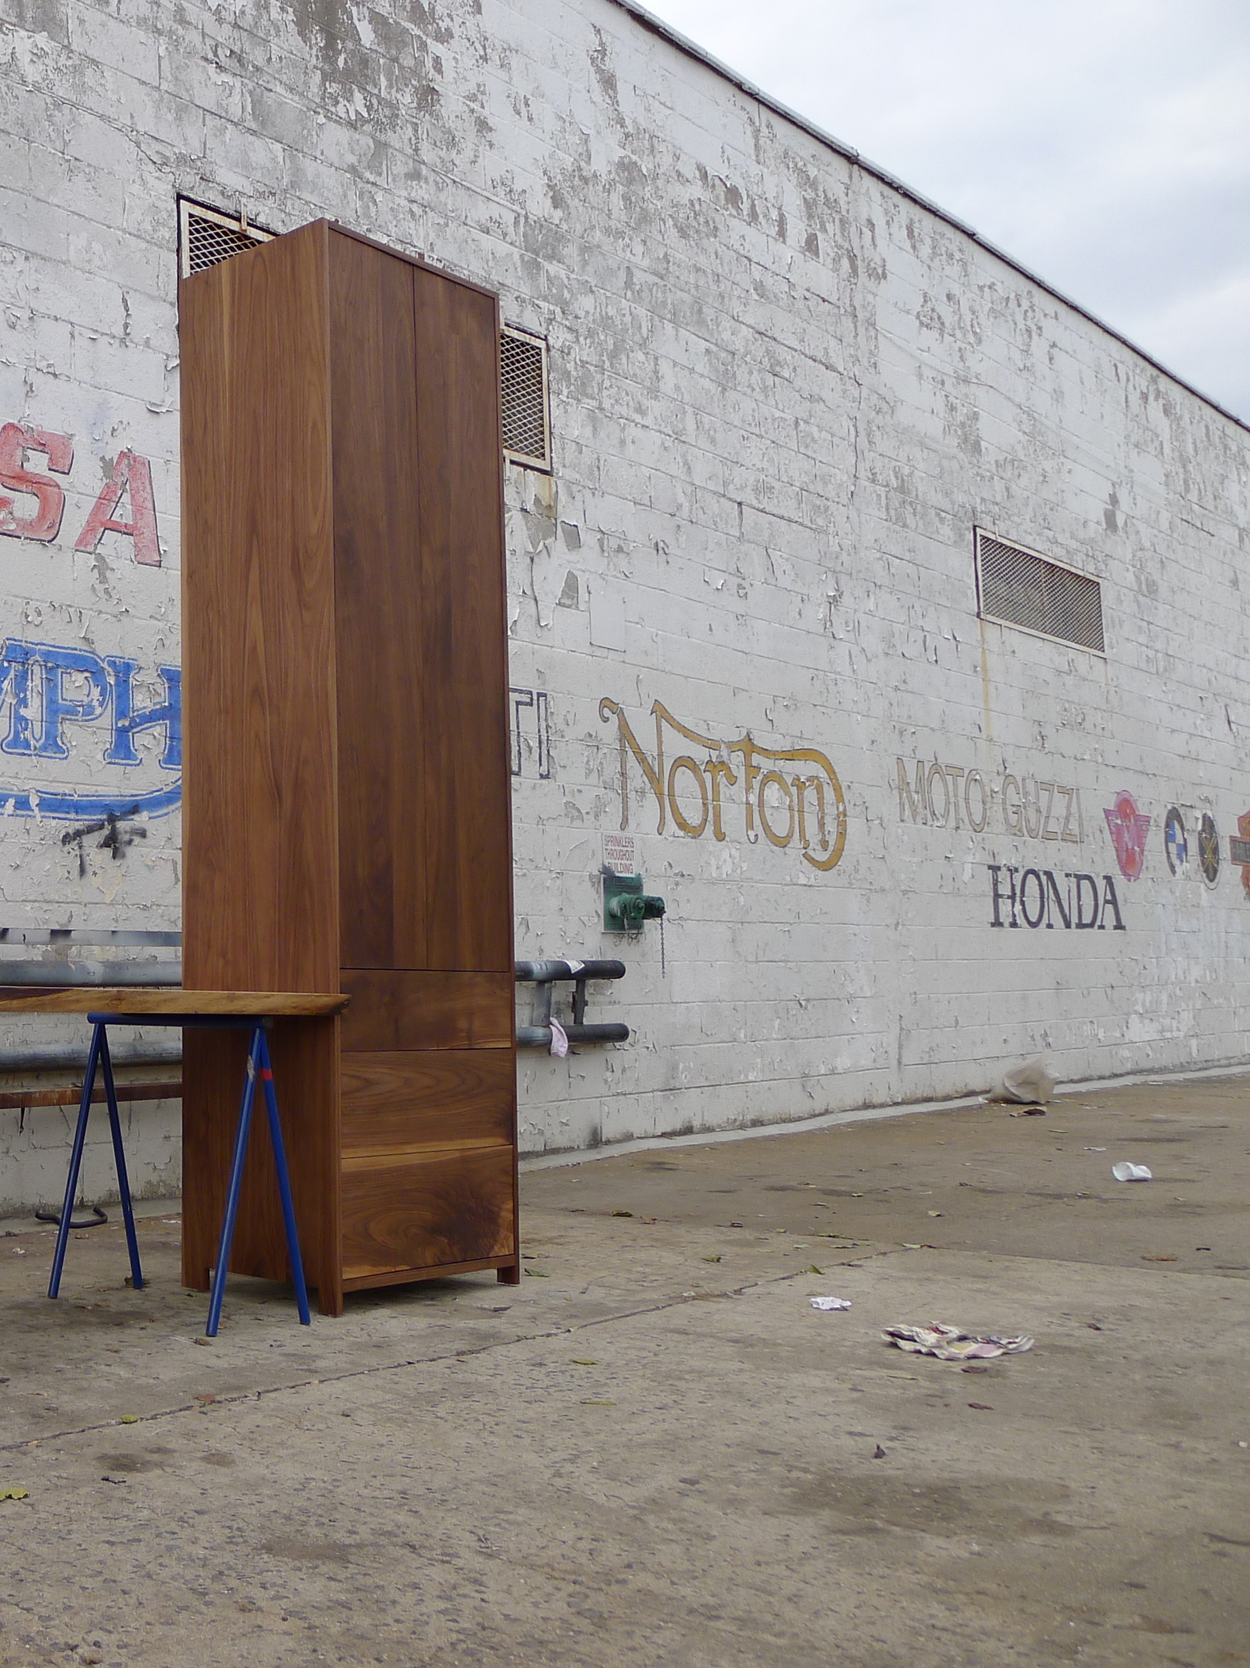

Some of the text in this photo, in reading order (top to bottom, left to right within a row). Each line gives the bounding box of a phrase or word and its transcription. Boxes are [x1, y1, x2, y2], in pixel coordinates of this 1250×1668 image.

[599, 697, 847, 872] Norton
[897, 757, 1085, 843] MOTO GUZZI
[604, 834, 635, 848] SPRINKLERS
[604, 848, 635, 861] THROUGHOUT
[987, 864, 1126, 931] HONDA
